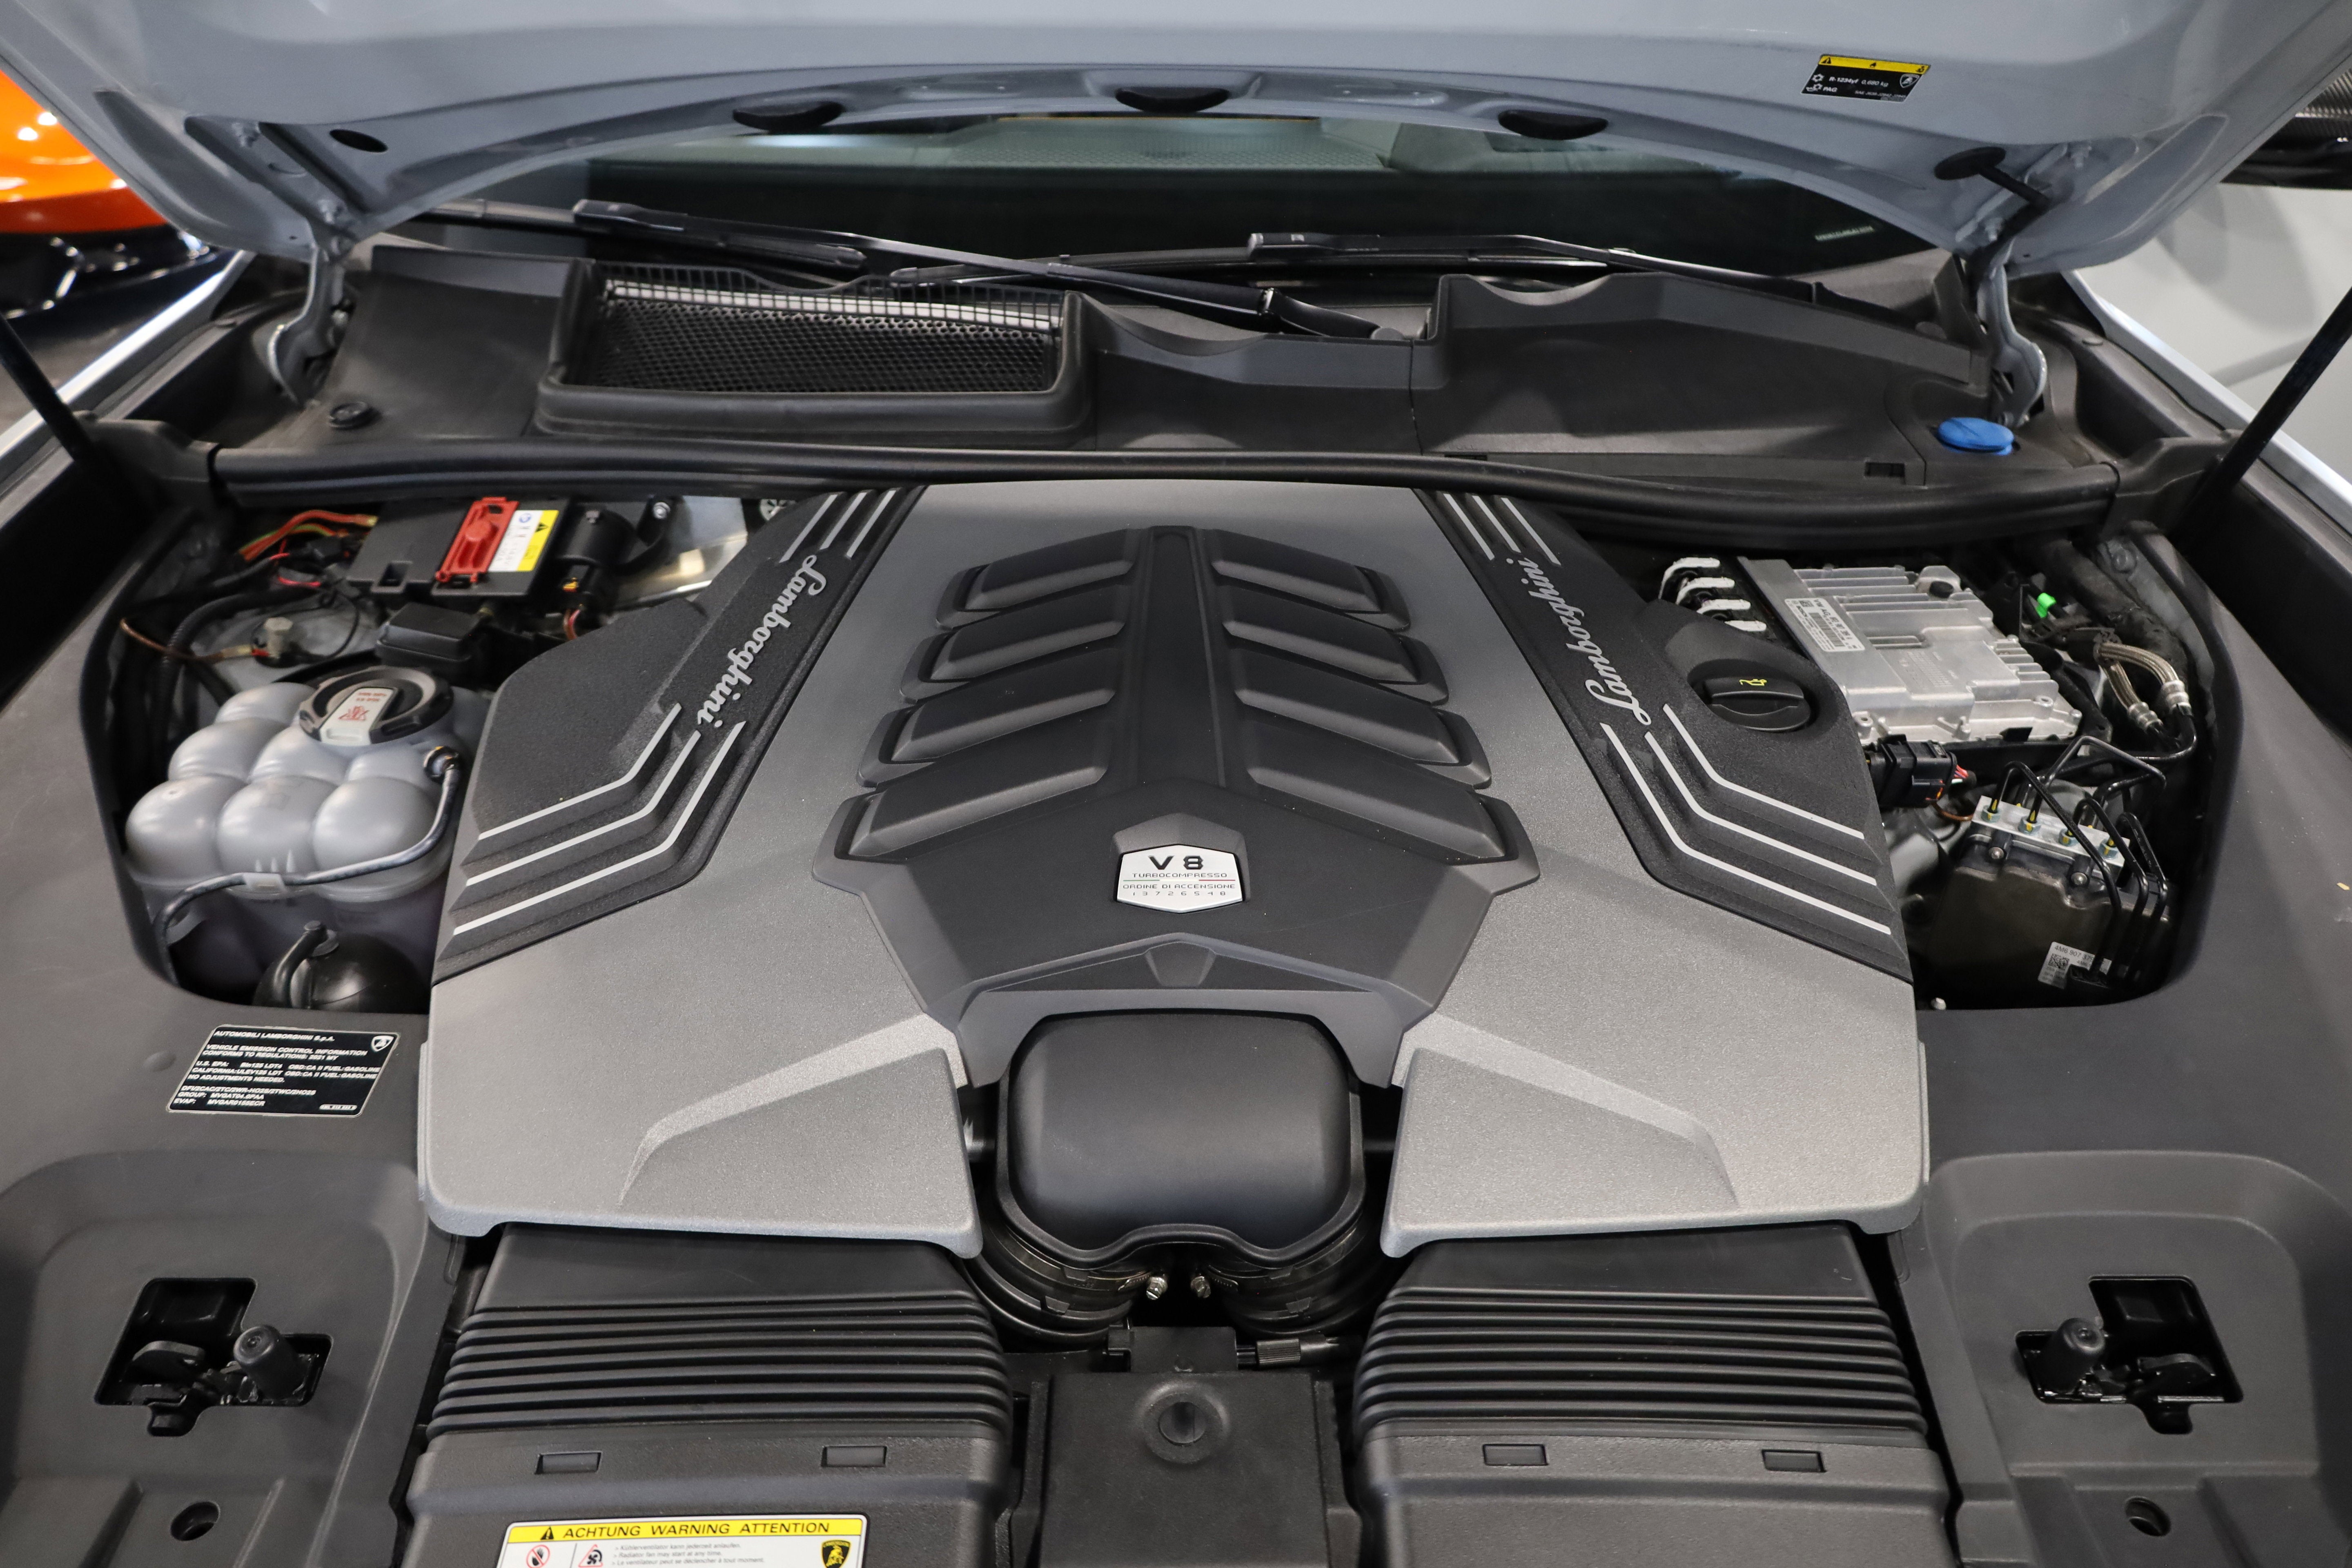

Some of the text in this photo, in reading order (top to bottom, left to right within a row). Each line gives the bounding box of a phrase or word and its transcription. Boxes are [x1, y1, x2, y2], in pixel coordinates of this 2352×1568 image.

[697, 555, 827, 728] Lamborghini
[1506, 557, 1652, 726] Lamborghini
[2055, 945, 2068, 953] 4M6
[563, 1523, 829, 1538] ACHTUNG WARNING ATTENTION
